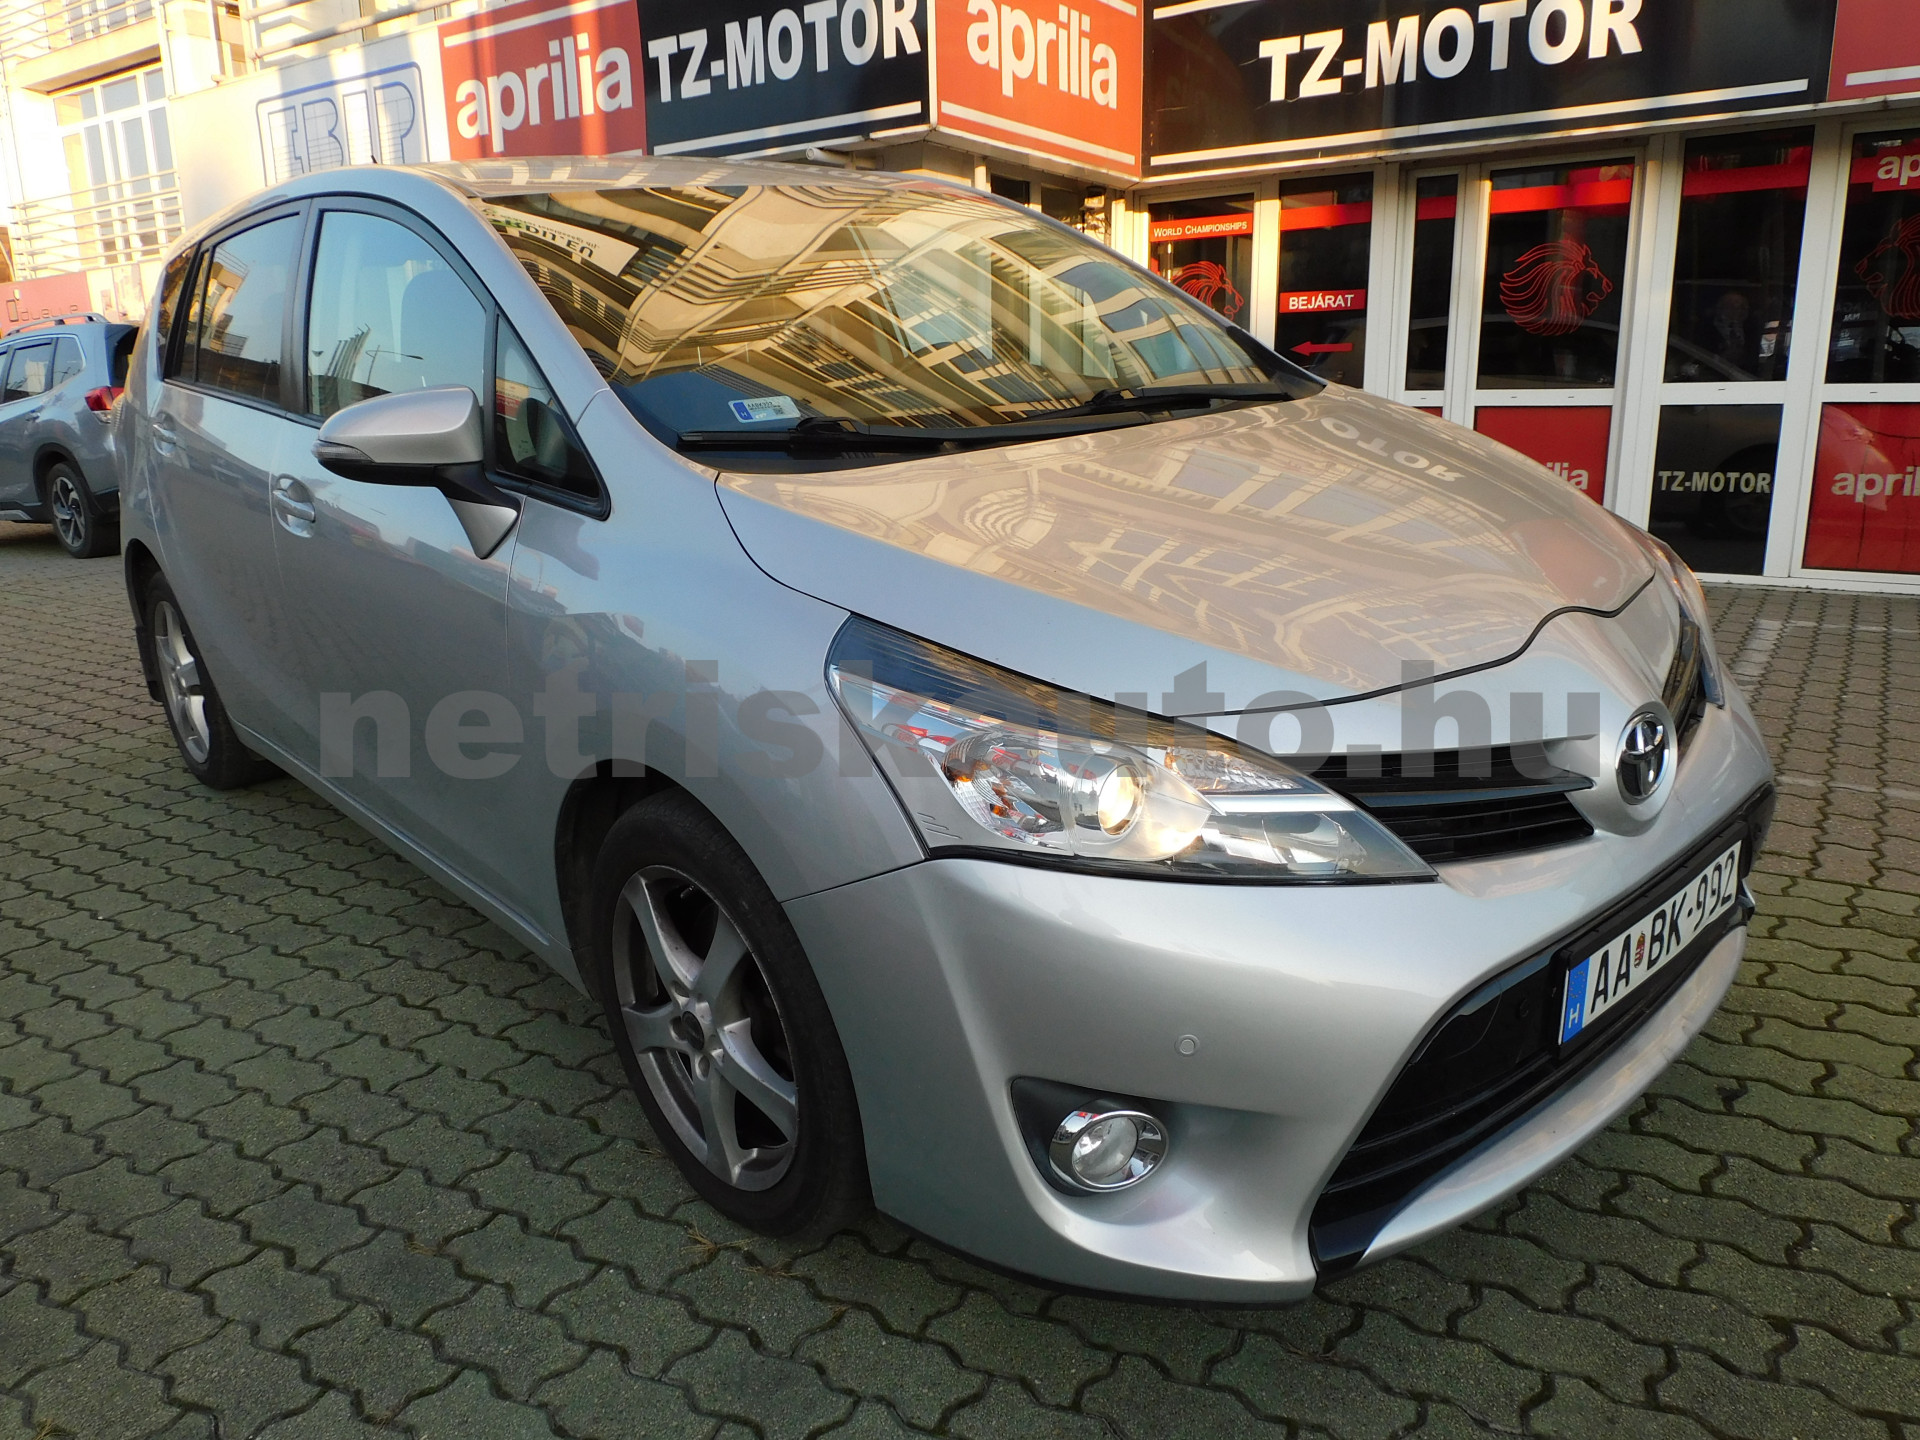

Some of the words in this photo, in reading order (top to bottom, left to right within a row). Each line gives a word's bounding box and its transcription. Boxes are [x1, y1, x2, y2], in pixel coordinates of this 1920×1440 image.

[648, 0, 922, 102] TZ-MOTOR
[967, 0, 1118, 110] aprilia
[1259, 0, 1642, 101] TZ-MOTOR
[456, 32, 633, 152] aprilia
[1877, 154, 1920, 186] ap
[1289, 293, 1355, 311] BEJÁRAT
[1658, 471, 1772, 494] TZ-MOTOR
[1568, 1003, 1580, 1029] H
